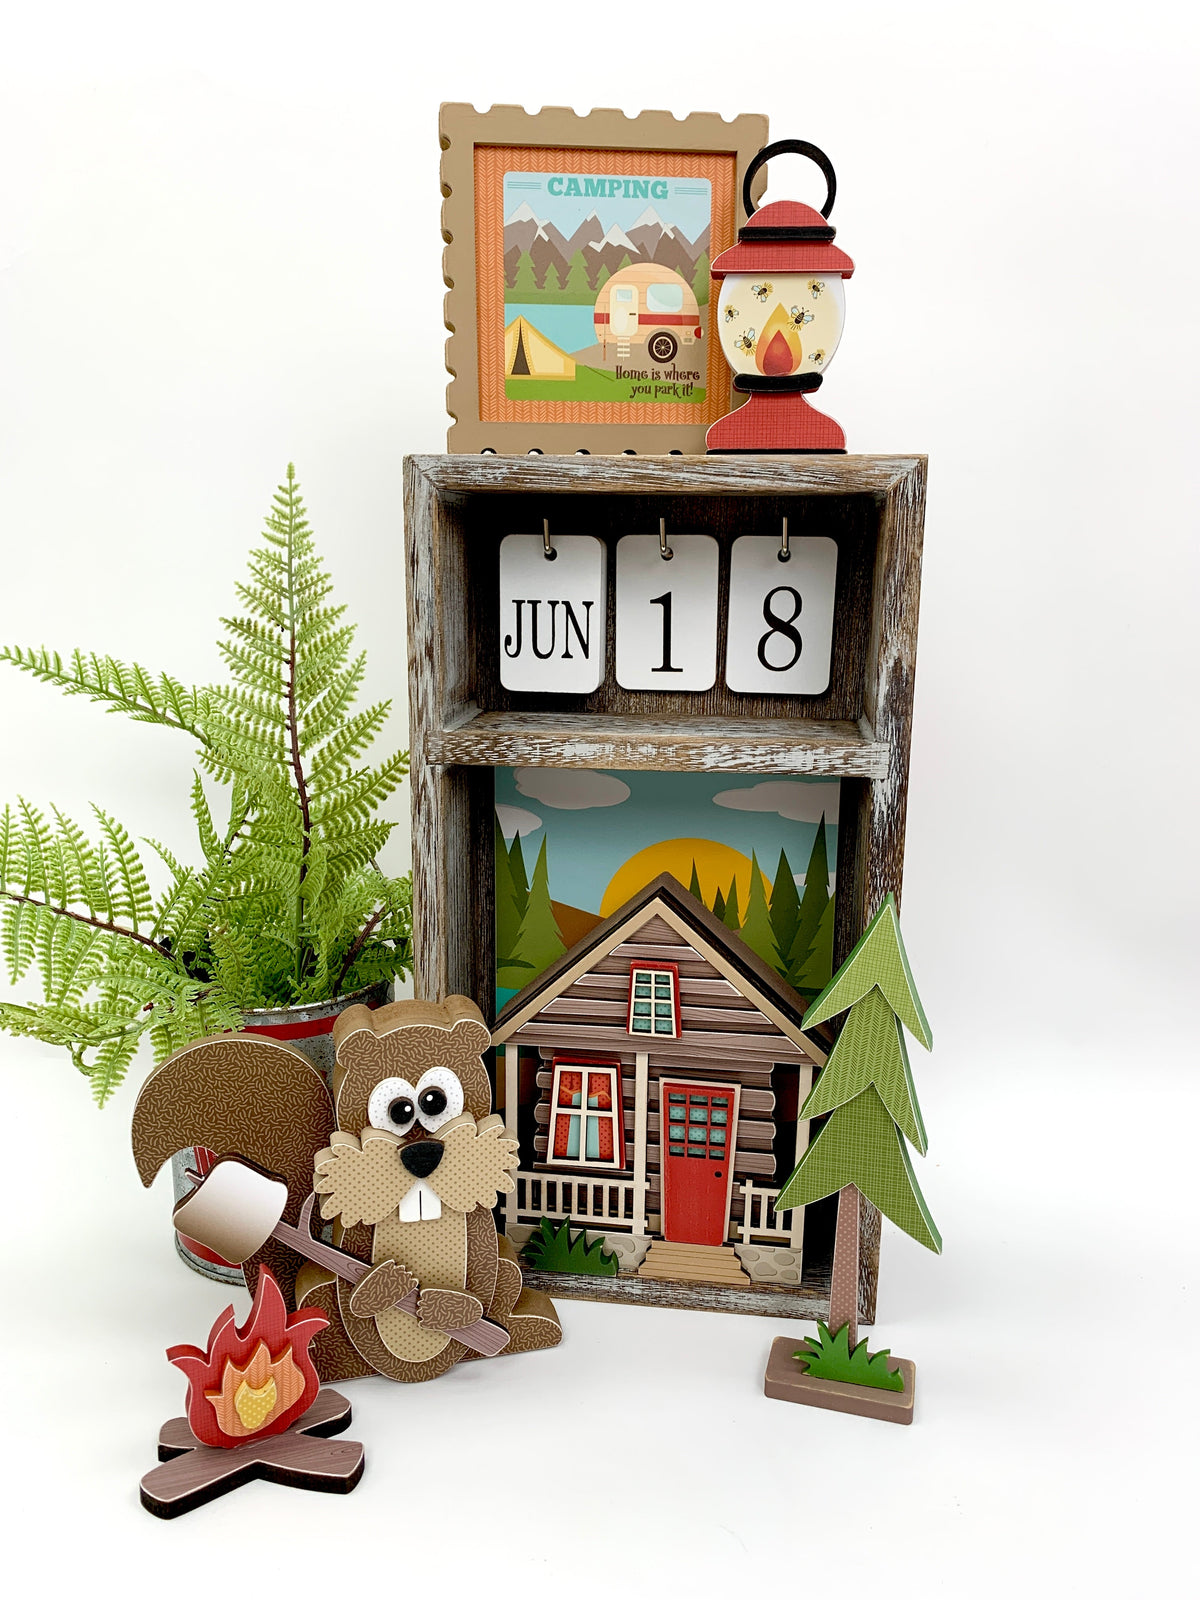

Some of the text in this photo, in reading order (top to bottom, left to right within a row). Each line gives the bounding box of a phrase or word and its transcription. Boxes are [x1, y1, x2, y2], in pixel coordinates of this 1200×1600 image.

[547, 176, 669, 200] CAMPING
[615, 363, 700, 381] Home is where
[629, 382, 694, 399] you park it!
[504, 585, 803, 673] JUN 1 8
